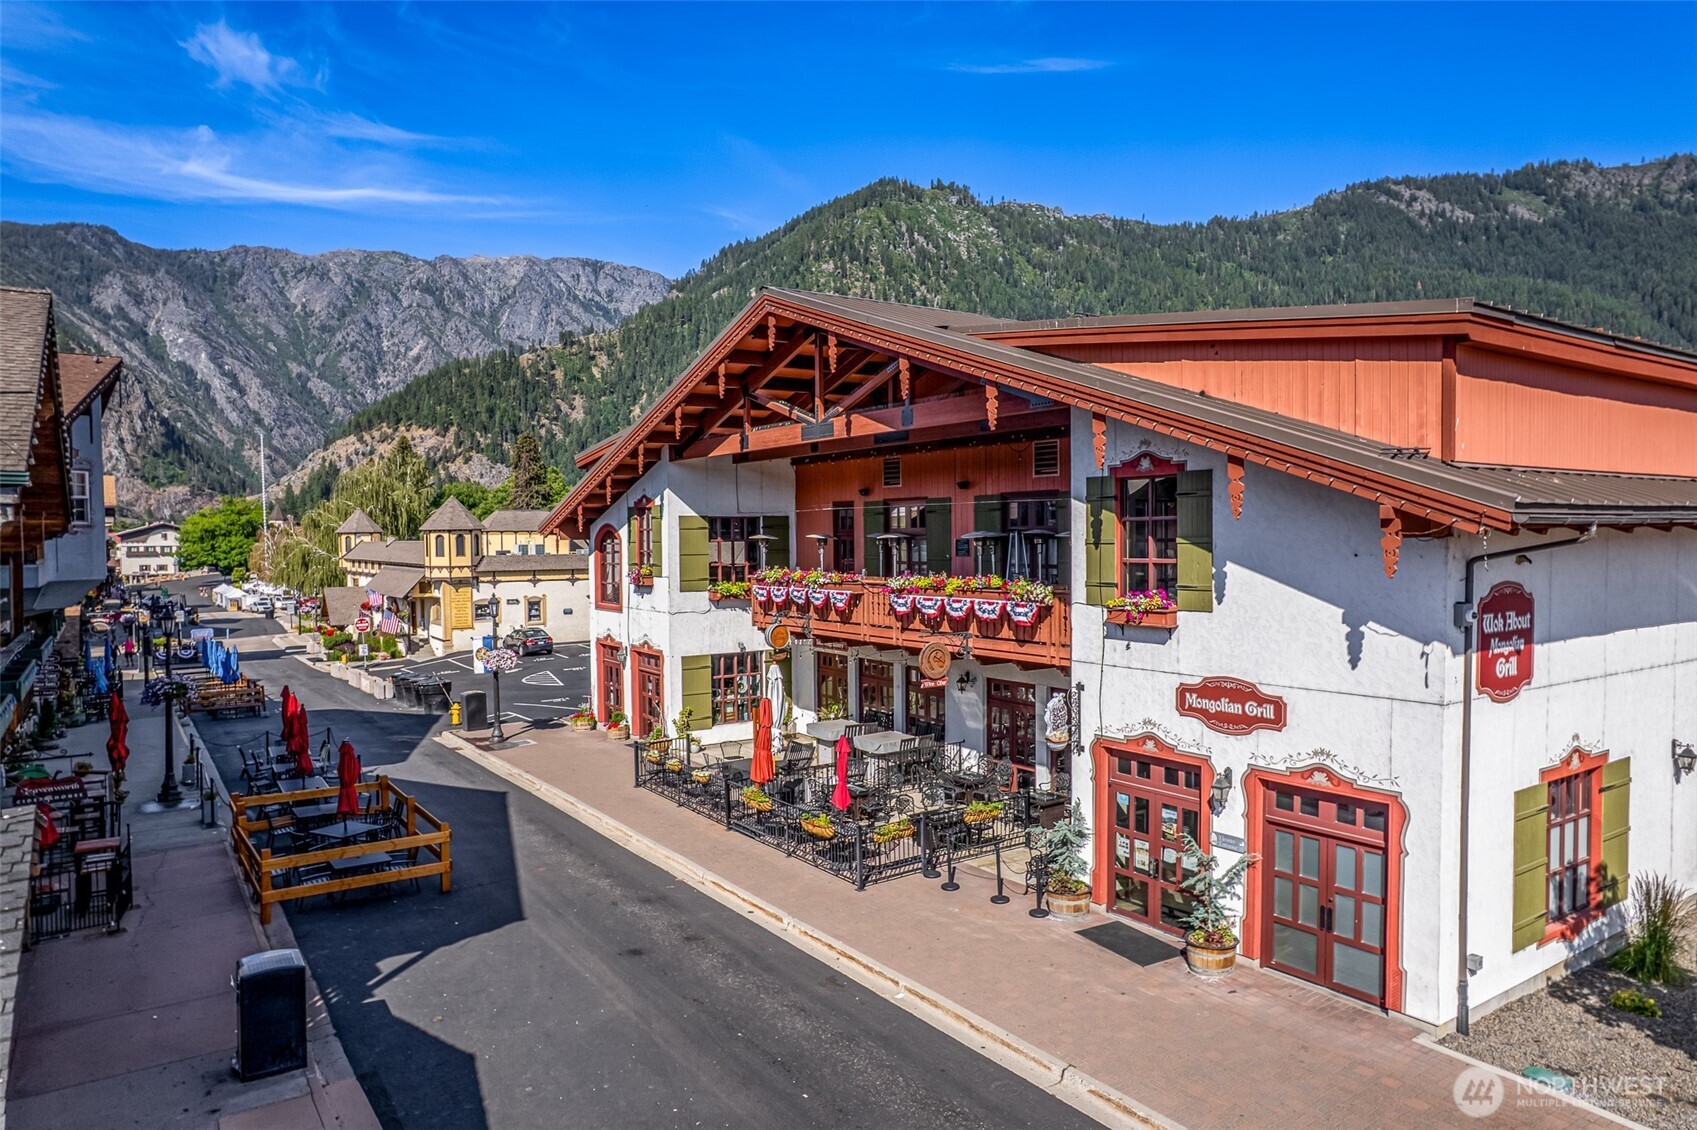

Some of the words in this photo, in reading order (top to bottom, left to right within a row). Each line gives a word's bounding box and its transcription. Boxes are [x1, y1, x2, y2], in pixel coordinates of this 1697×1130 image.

[1483, 613, 1504, 634] Wok
[1506, 611, 1531, 632] About
[1489, 635, 1525, 658] Mongolian
[1496, 657, 1517, 678] Grill
[1185, 693, 1243, 715] Mongolian
[1245, 701, 1276, 719] Grill
